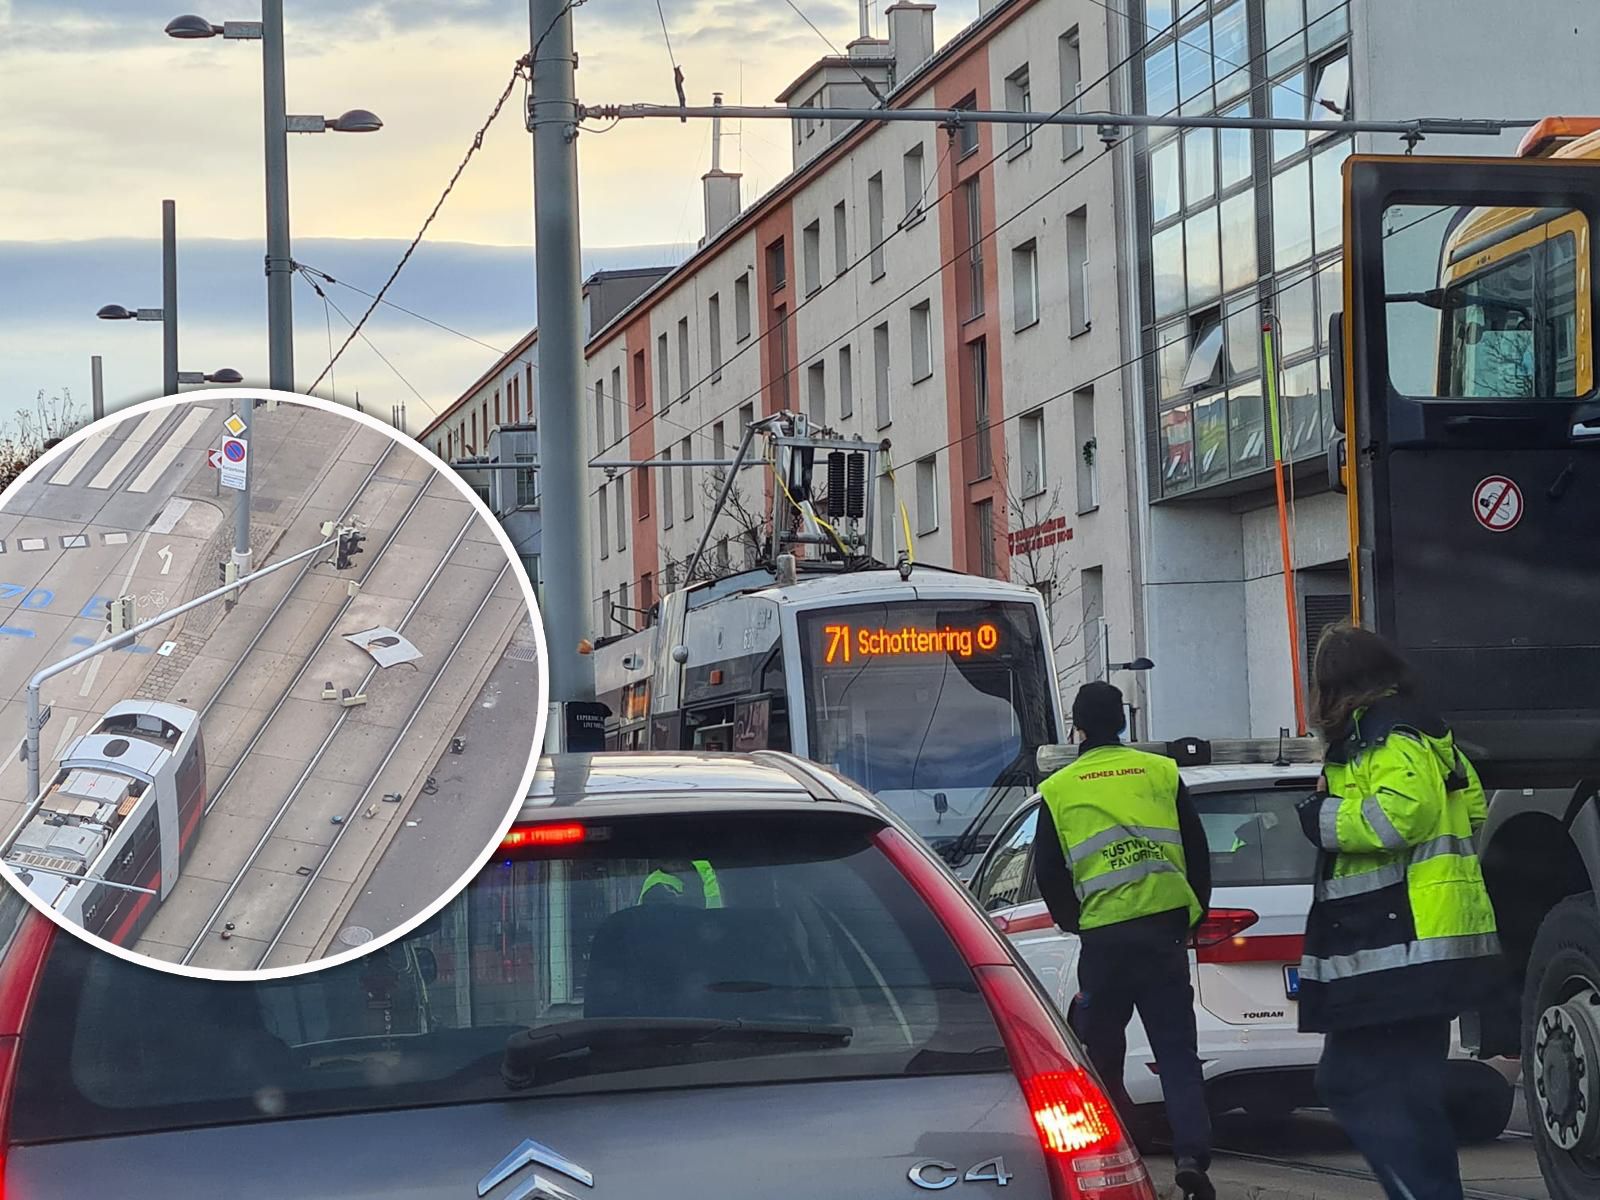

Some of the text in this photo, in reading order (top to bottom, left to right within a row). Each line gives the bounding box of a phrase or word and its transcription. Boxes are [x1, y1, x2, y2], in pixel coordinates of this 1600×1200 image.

[824, 626, 850, 663] 71
[858, 626, 972, 656] Schottenring
[1079, 767, 1145, 780] WIENER LINIEN
[907, 1156, 1014, 1190] C4
